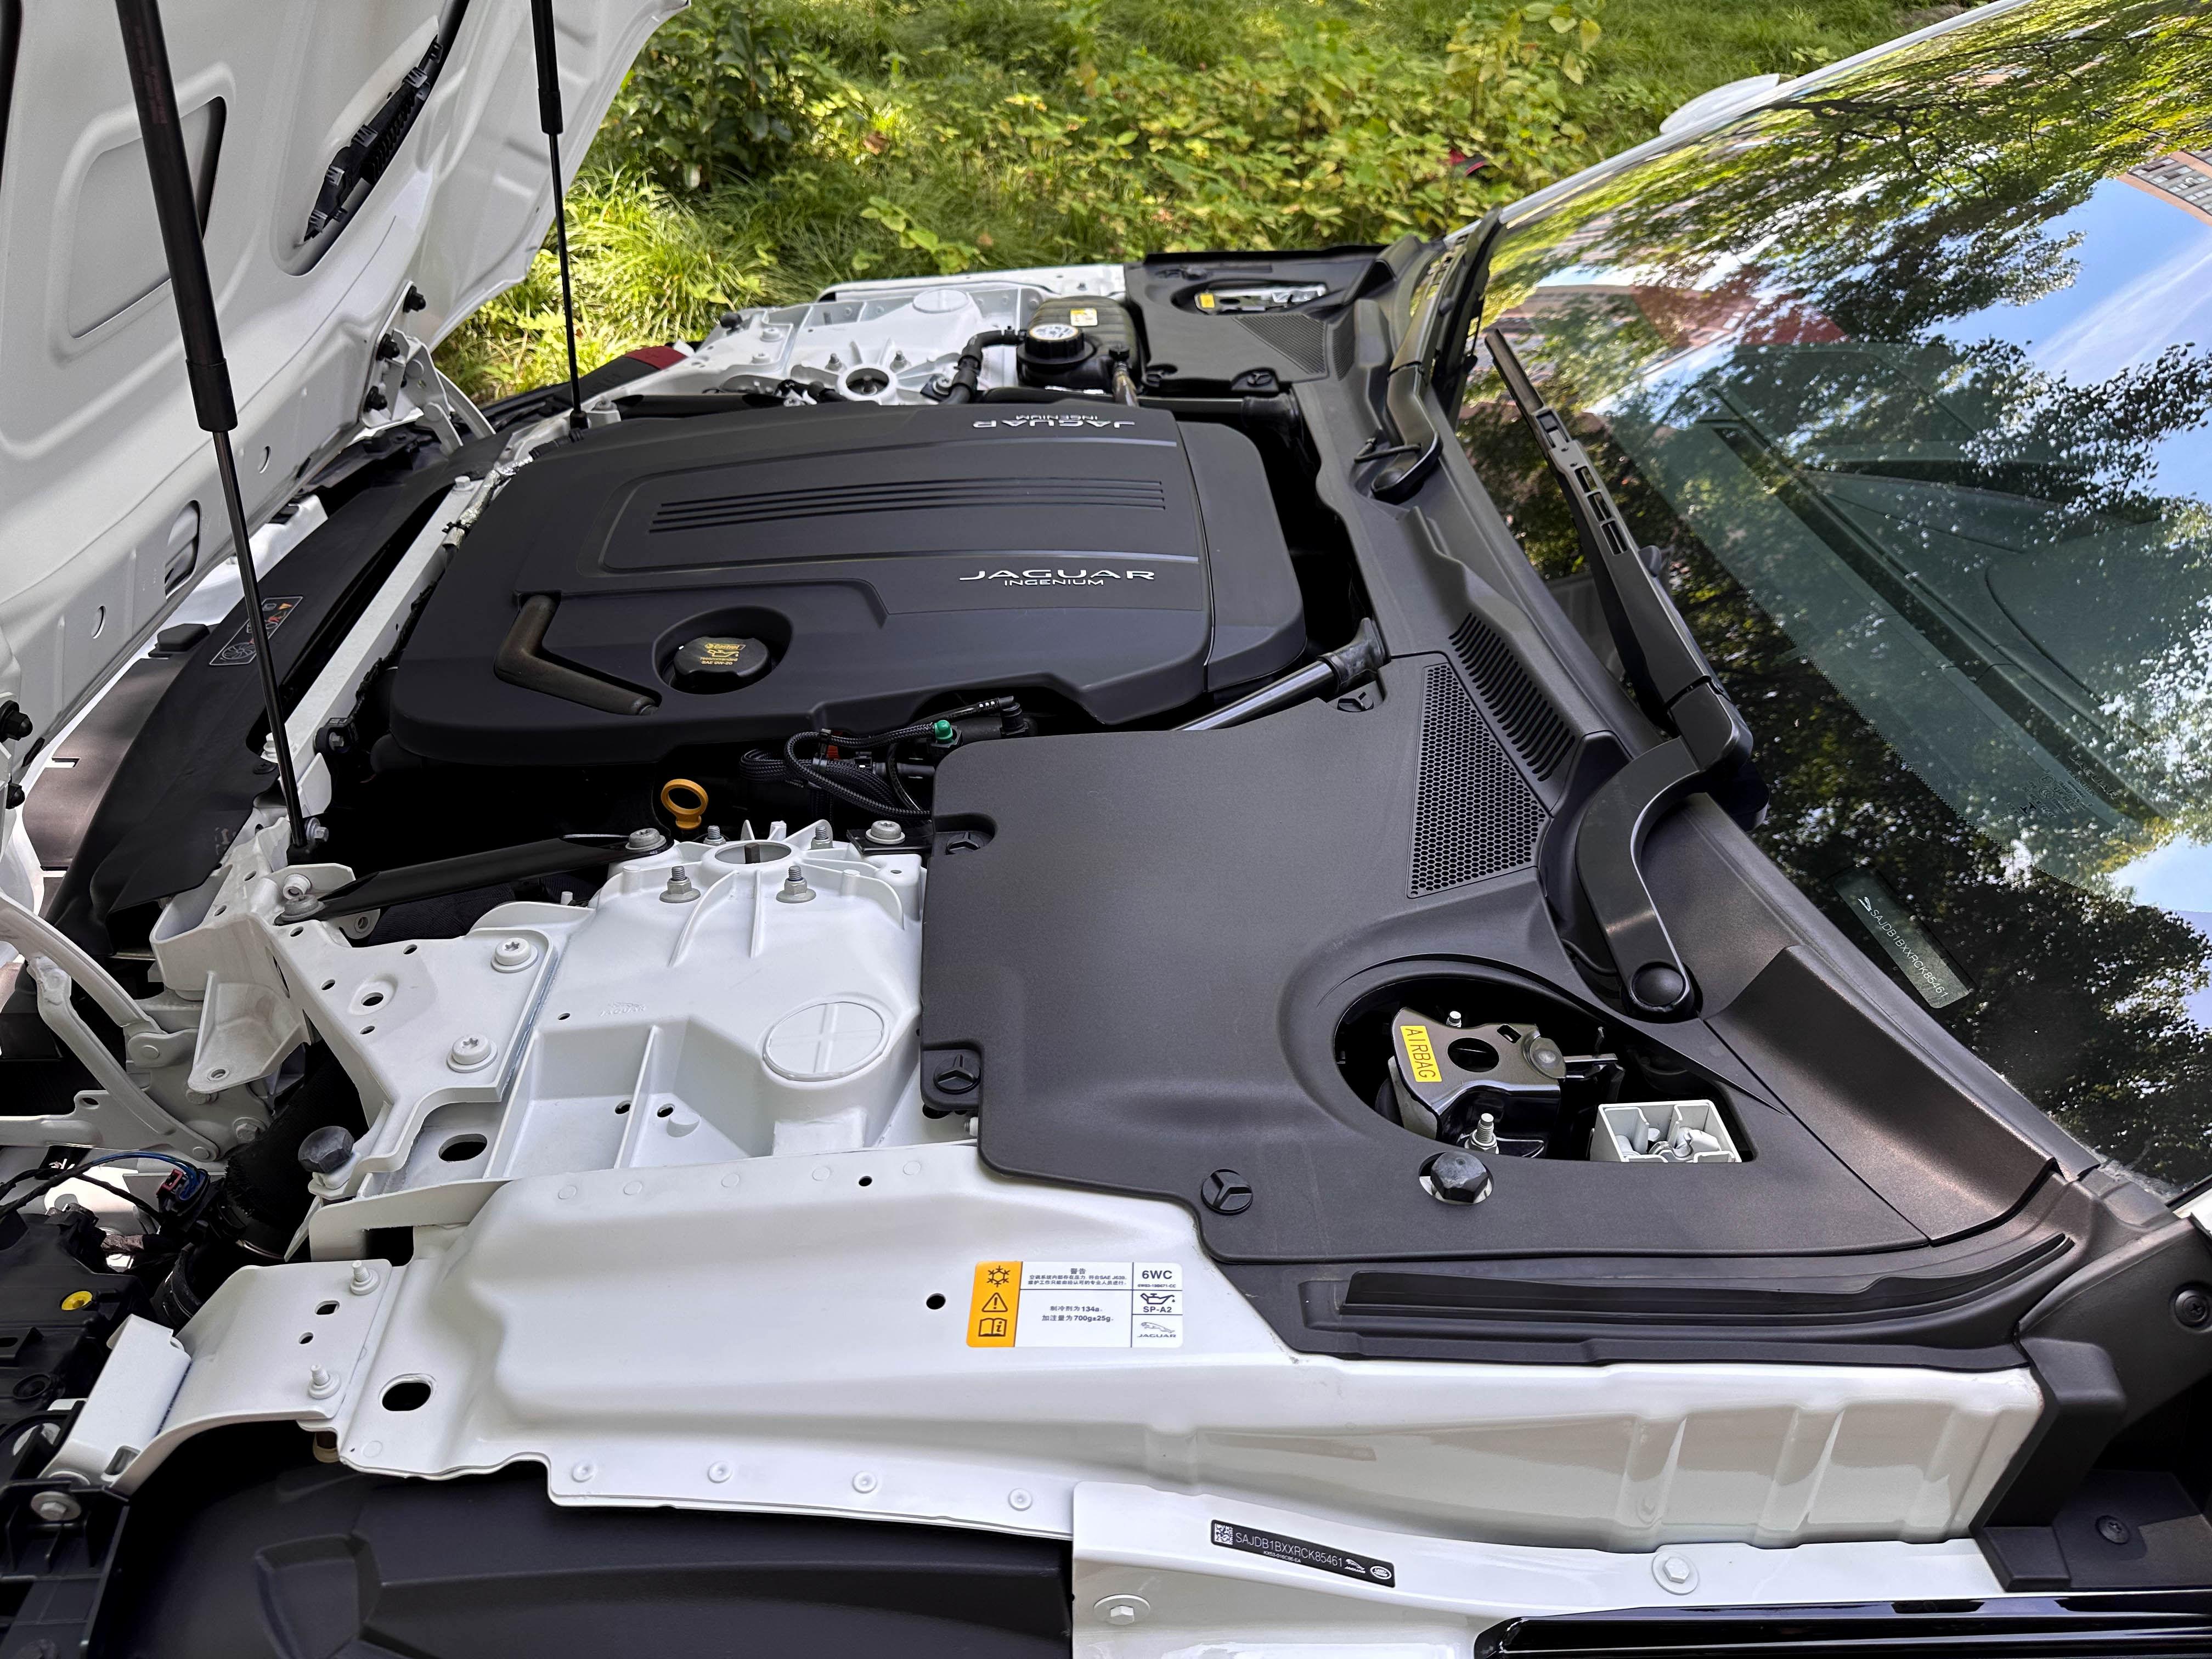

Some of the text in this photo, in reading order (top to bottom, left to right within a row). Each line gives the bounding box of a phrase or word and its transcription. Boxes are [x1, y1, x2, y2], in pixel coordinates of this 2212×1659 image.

[973, 419, 1135, 428] JAGUAR
[959, 569, 1155, 580] JAGUAR
[1870, 909, 1949, 997] SAJDB1BXXRCK85461
[1405, 1028, 1436, 1078] AIRBAG
[1142, 1270, 1172, 1279] 6WC
[1235, 1532, 1342, 1567] SAJDB1BXXRCK85461
